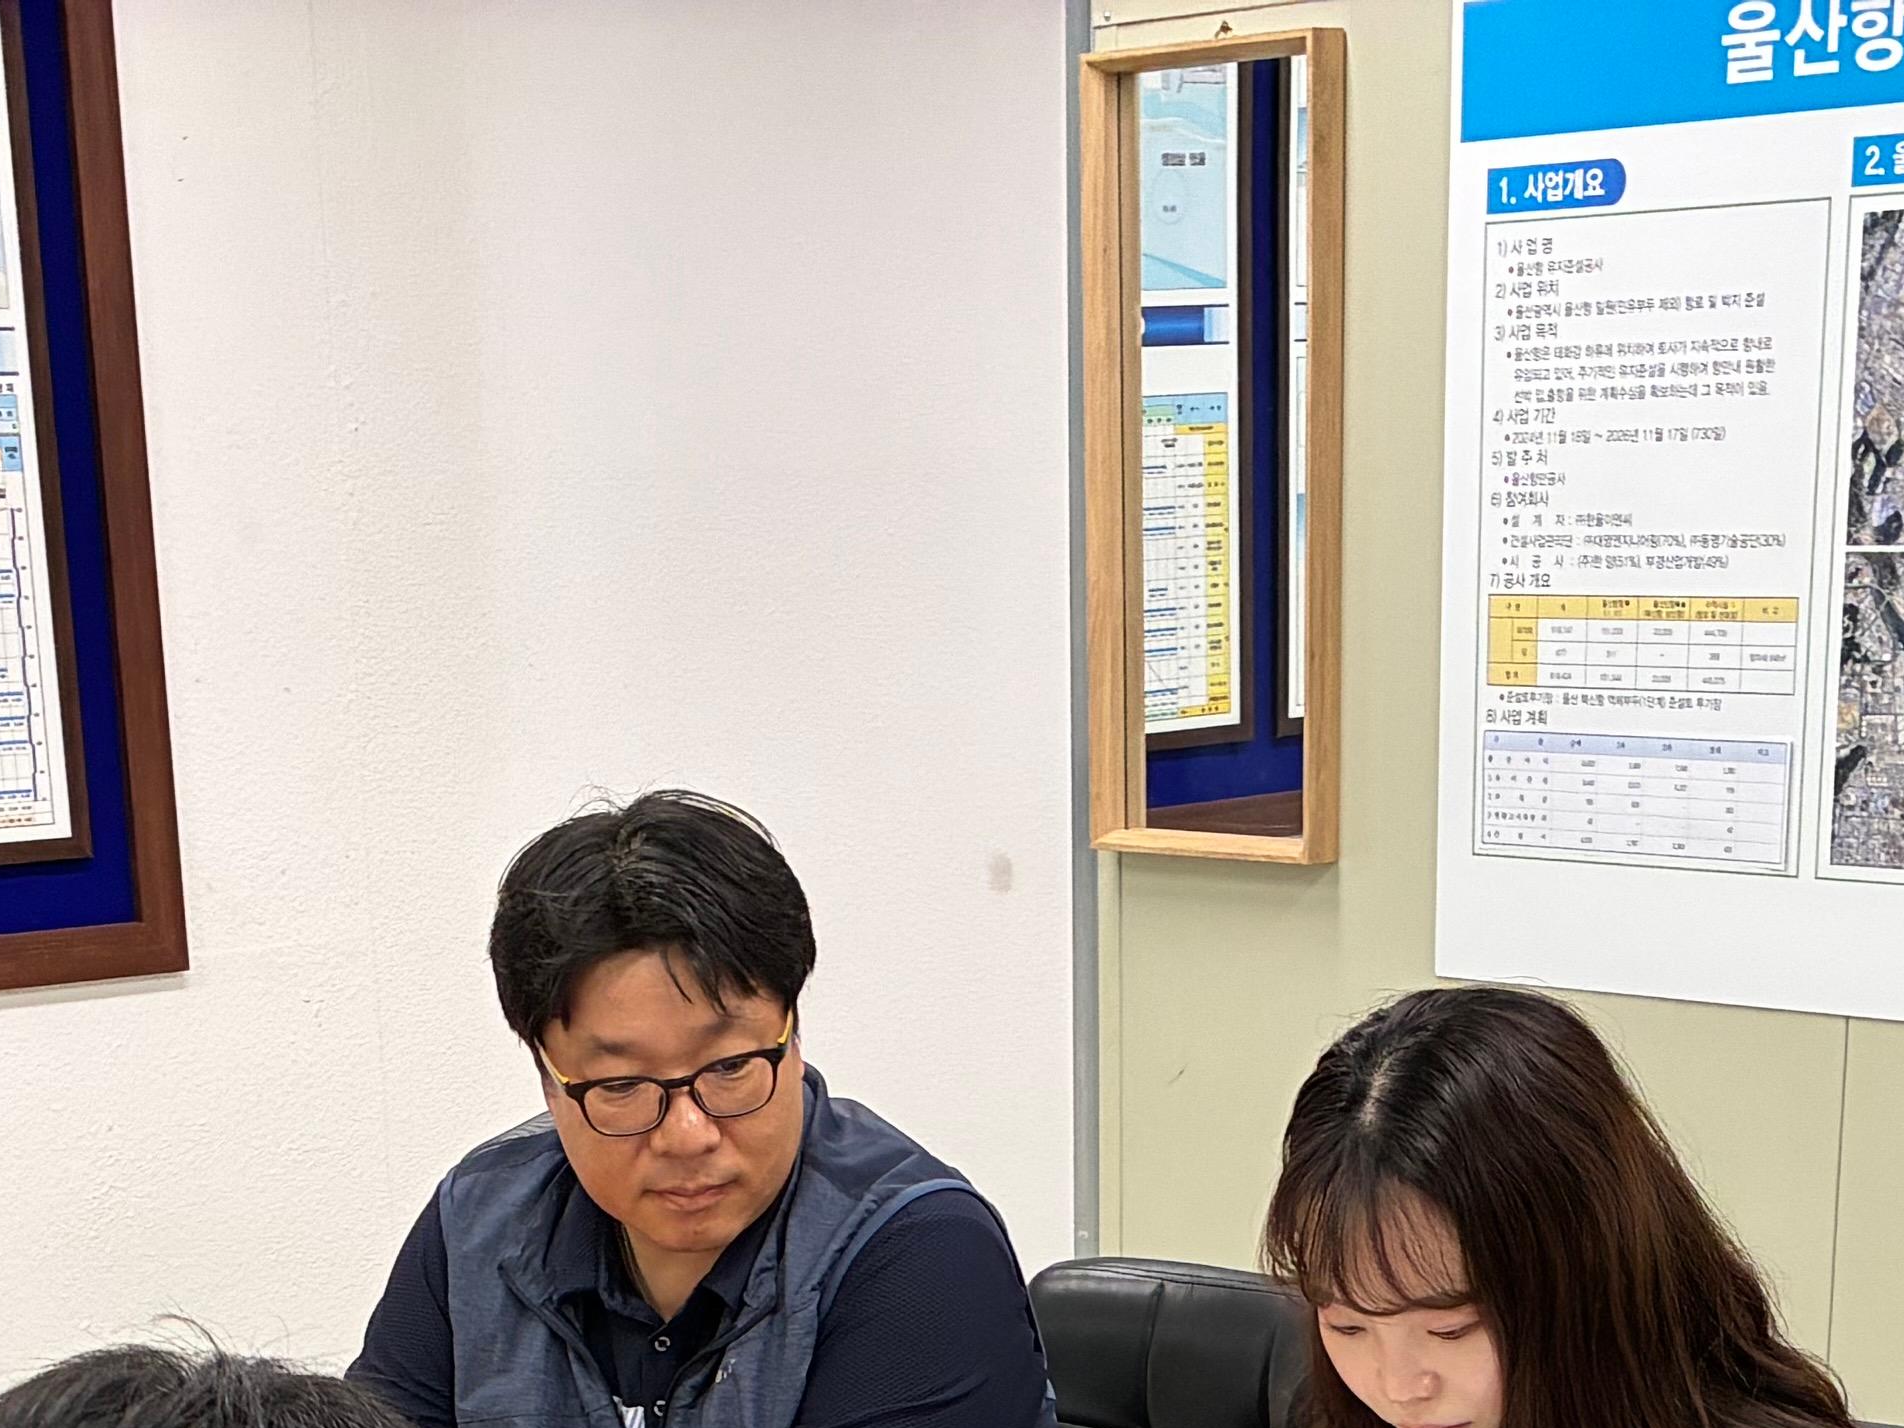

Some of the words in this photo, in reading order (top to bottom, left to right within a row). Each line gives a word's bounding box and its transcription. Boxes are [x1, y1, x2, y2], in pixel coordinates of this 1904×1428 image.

[1864, 145, 1885, 176] 2.
[1499, 175, 1516, 204] 1.
[1524, 167, 1605, 200] 사업개요
